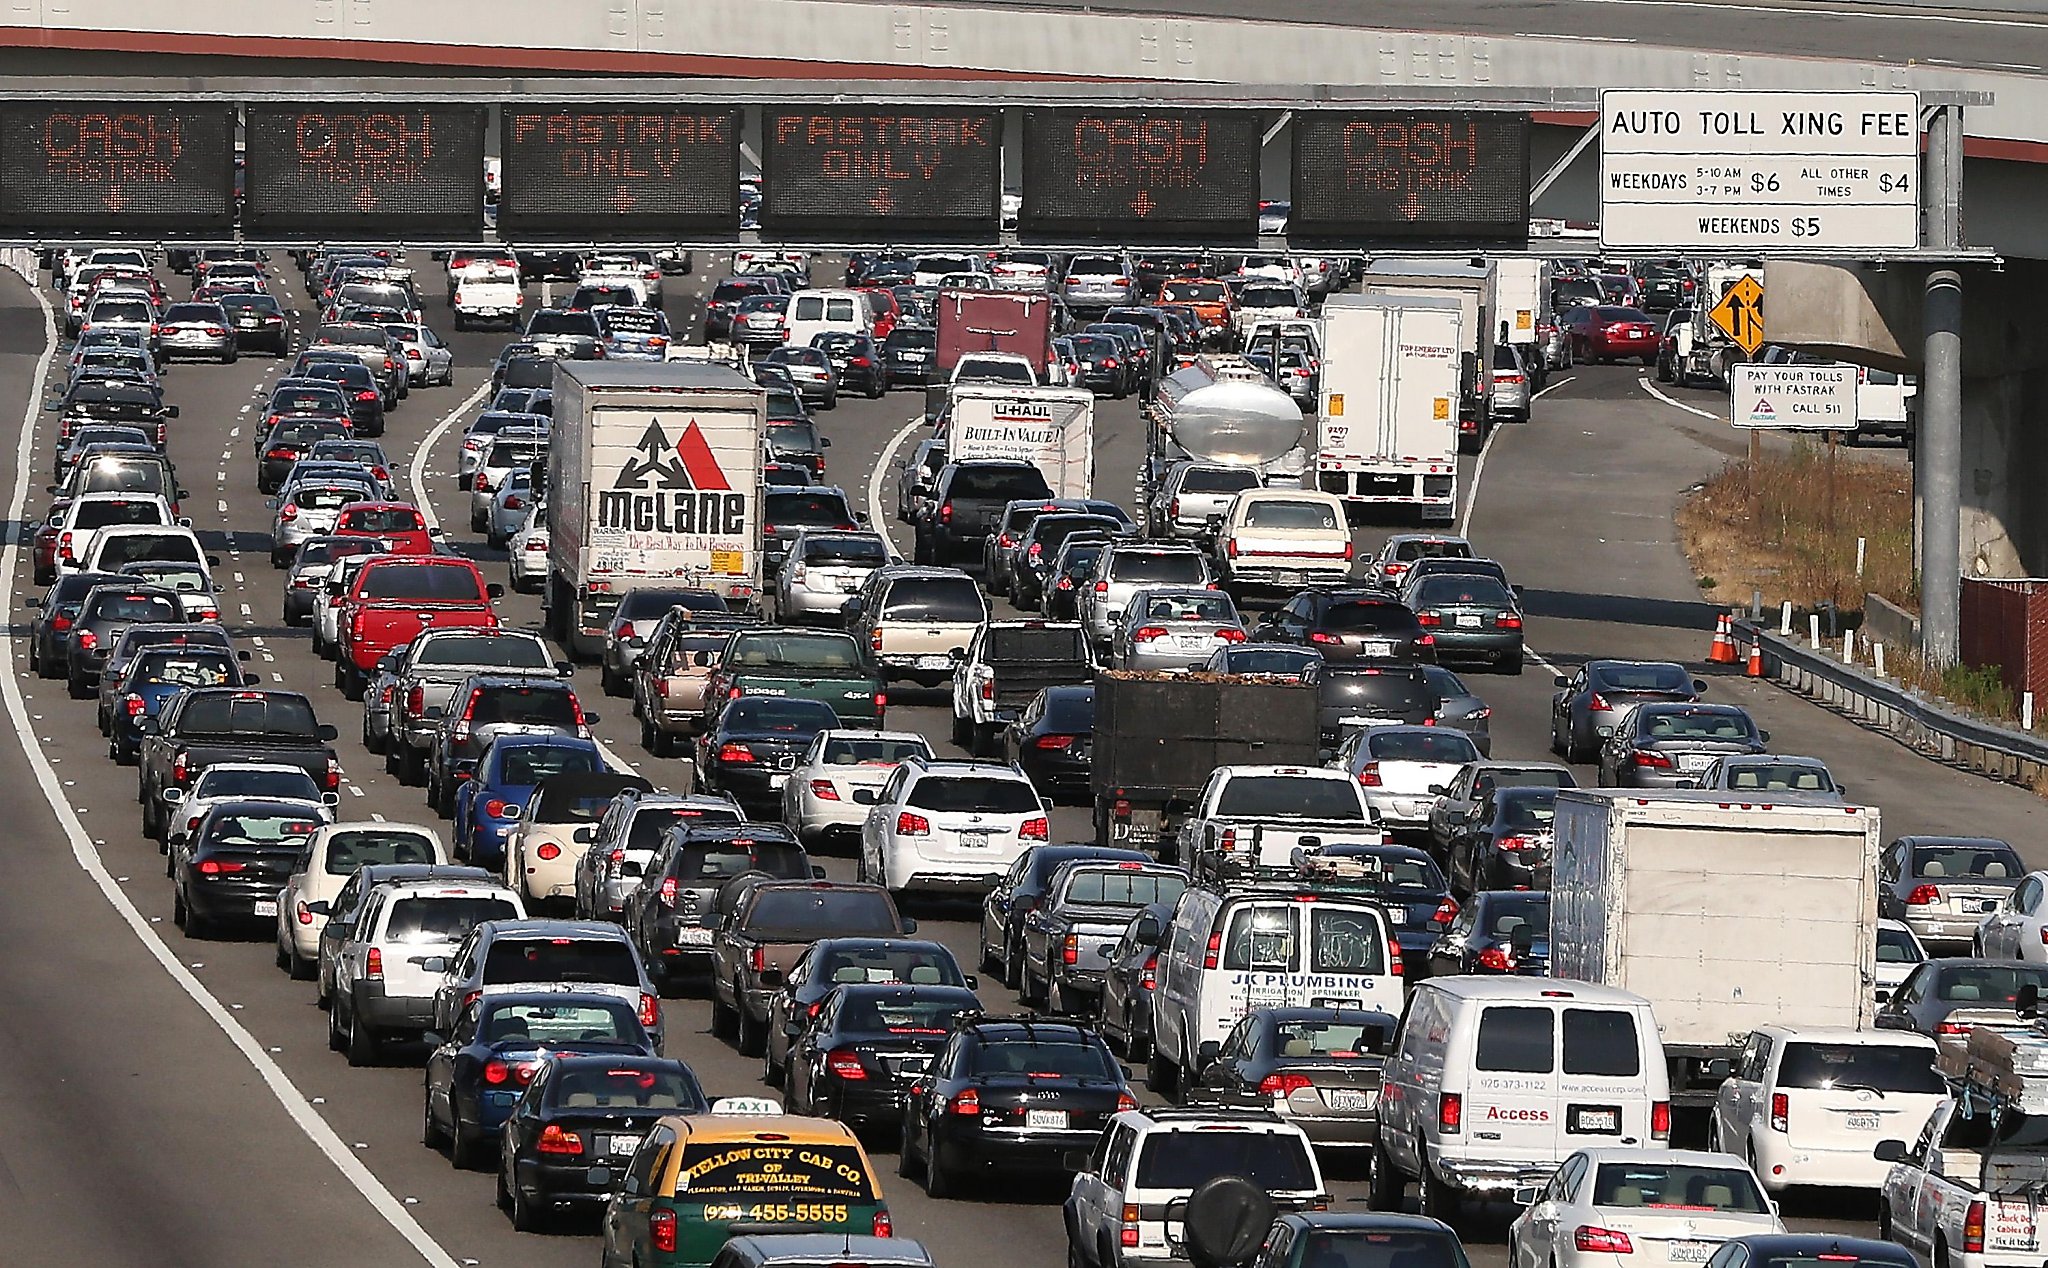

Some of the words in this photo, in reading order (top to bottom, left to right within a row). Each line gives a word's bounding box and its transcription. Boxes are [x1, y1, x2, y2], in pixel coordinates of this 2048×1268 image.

[515, 114, 727, 144] FASTRAK
[777, 116, 987, 147] FASTRAK
[1611, 111, 1681, 135] AUTO
[1699, 111, 1765, 136] TOLL
[1781, 112, 1843, 137] XING
[1861, 113, 1909, 137] FEE
[44, 113, 182, 158] CASH
[296, 113, 432, 158] CASH
[1074, 118, 1207, 164] CASH
[1343, 121, 1476, 167] CASH
[47, 160, 177, 182] FASTRAK
[300, 160, 427, 182] FASTRAK
[561, 149, 680, 178] ONLY
[822, 150, 941, 180] ONLY
[1076, 166, 1201, 189] FASTRAK
[1346, 168, 1472, 191] FASTRAK
[1610, 172, 1688, 190] WEEKDAYS
[1696, 168, 1721, 179] 5-10
[1724, 168, 1741, 179] AM
[1751, 172, 1780, 194] $6
[1800, 168, 1822, 180] ALL
[1830, 168, 1869, 180] OTHER
[1696, 185, 1718, 196] 3-7
[1724, 185, 1741, 196] PM
[1818, 186, 1852, 198] TIMES
[1879, 173, 1909, 194] $4
[1698, 218, 1780, 235] WEEKENDS
[1791, 217, 1821, 238] $5
[1747, 371, 1768, 382] PAY
[1774, 371, 1804, 382] YOUR
[1810, 372, 1843, 382] TOLLS
[1754, 385, 1781, 395] WITH
[1786, 385, 1836, 396] FASTRAK
[995, 404, 1051, 417] U-HAUL
[1792, 403, 1820, 414] CALL
[1825, 404, 1841, 414] 511
[1017, 427, 1060, 443] VALUE!
[628, 534, 644, 549] The
[646, 536, 664, 549] Best
[666, 536, 682, 550] Way
[686, 536, 695, 549] To
[696, 537, 707, 550] Do
[709, 537, 745, 551] Business
[1231, 974, 1258, 985] JK
[1266, 975, 1375, 989] PLUMBING
[1252, 988, 1303, 996] IRRIGATION
[1312, 989, 1361, 997] SPRINKLER
[727, 1100, 769, 1112] TAXI
[1487, 1106, 1549, 1121] Access
[687, 1149, 751, 1178] YELLOW
[753, 1148, 793, 1160] CITY
[799, 1151, 833, 1169] CAB
[836, 1164, 861, 1185] CO.
[763, 1163, 783, 1173] OF
[736, 1173, 811, 1184] TRI-VALLEY
[749, 1203, 848, 1222] 455-5555
